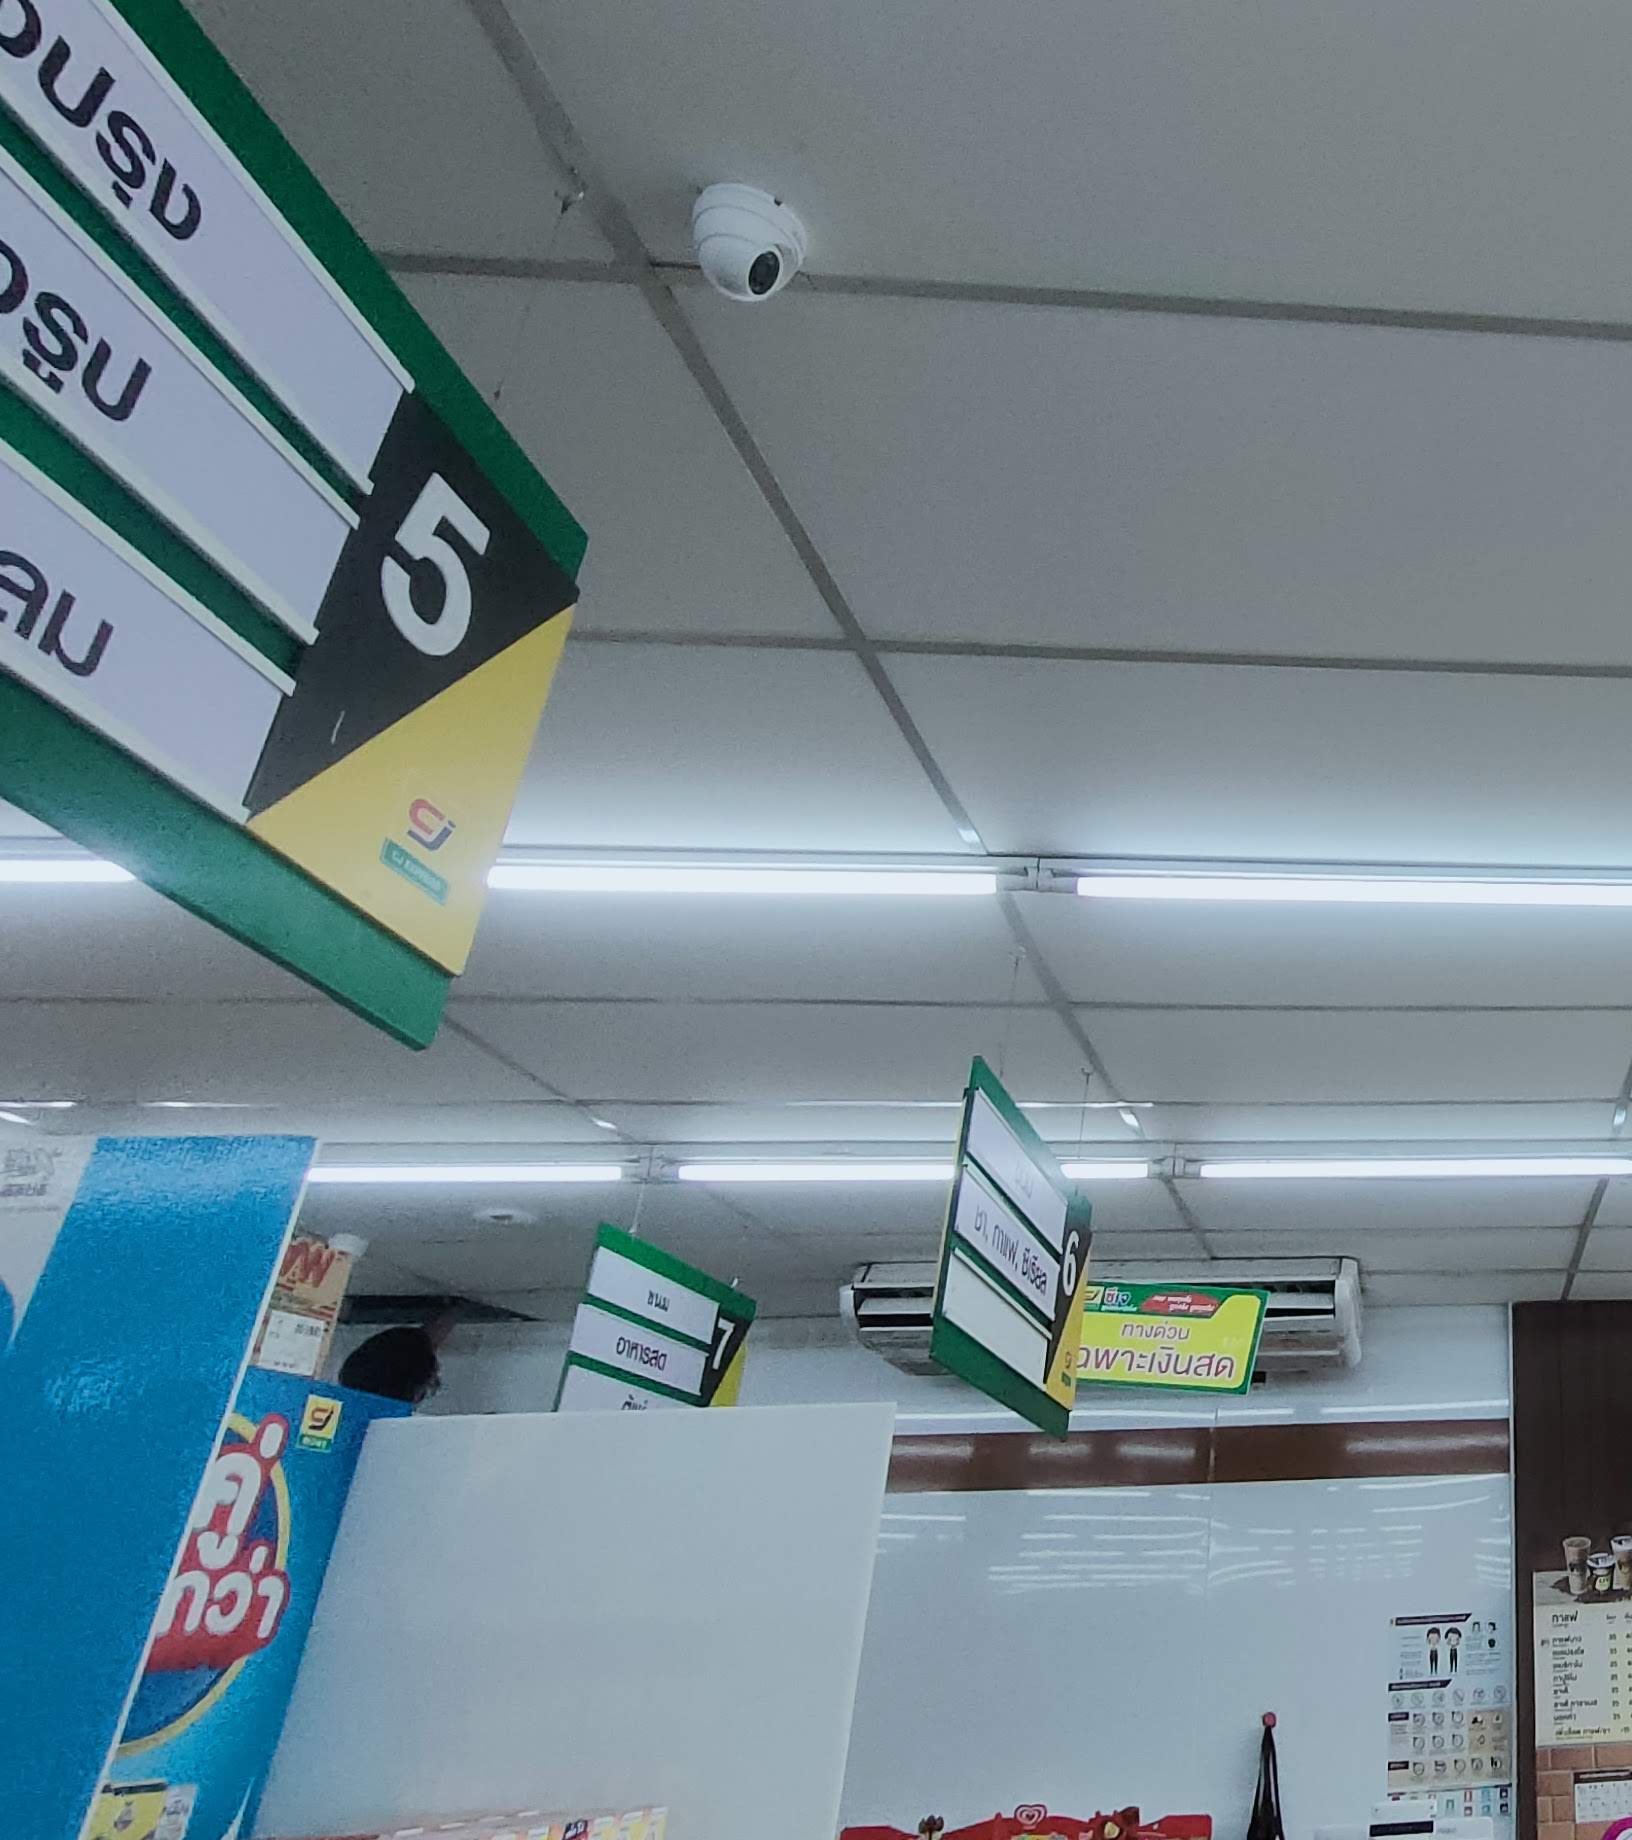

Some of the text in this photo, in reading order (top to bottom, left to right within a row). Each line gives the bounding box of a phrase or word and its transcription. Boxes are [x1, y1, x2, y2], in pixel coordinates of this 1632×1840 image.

[382, 473, 490, 656] 5
[1062, 1230, 1080, 1297] 6
[712, 1317, 736, 1371] 7
[1121, 1320, 1191, 1341] ทางด่วน
[616, 1336, 668, 1372] อาหารสด
[1077, 1345, 1235, 1379] ฉพาะเงินสด
